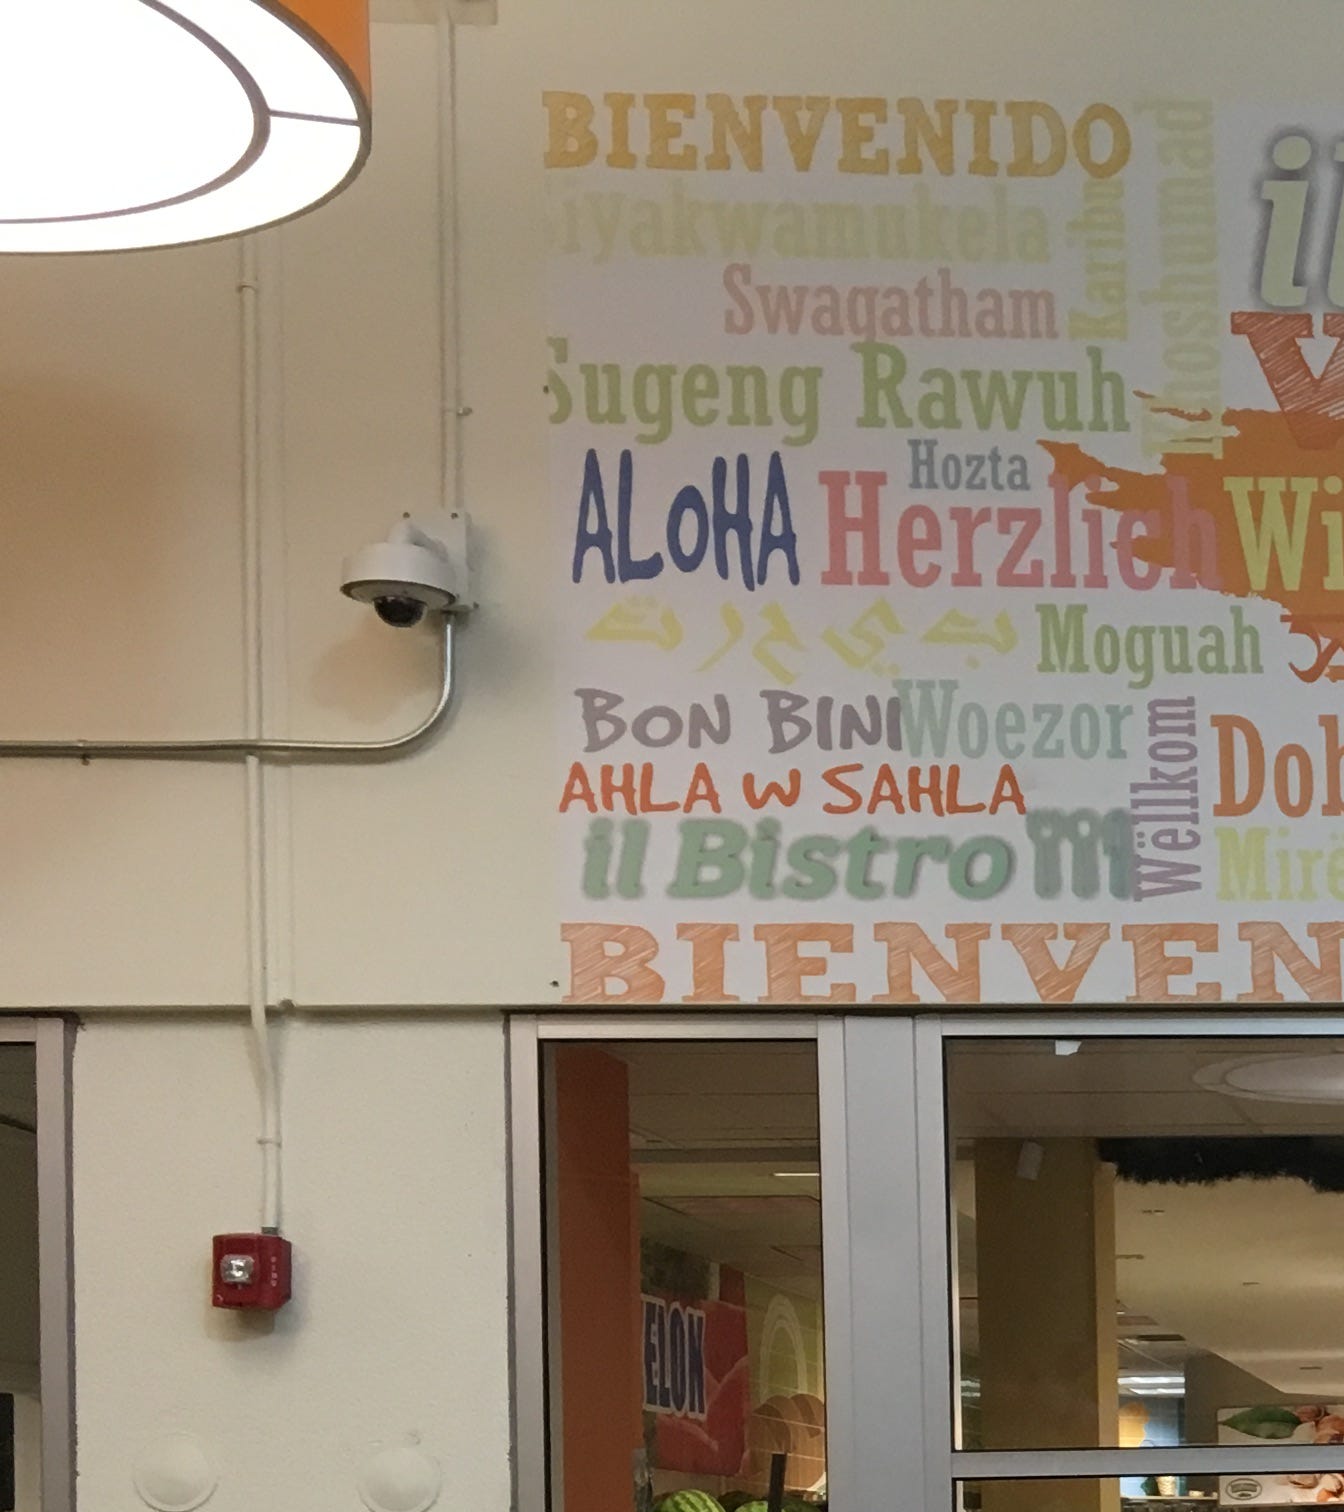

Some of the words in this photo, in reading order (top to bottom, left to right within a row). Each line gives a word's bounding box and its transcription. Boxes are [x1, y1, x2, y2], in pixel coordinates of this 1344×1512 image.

[541, 91, 1132, 178] BIENVENIDO
[851, 341, 1130, 432] Rawuh
[908, 439, 1030, 491] Hozta
[572, 448, 800, 592] ALOHA
[819, 469, 1224, 590] Herzlich
[1036, 603, 1264, 689] Moguah
[574, 687, 730, 753] BON
[759, 689, 900, 753] BINI
[894, 679, 1133, 760] Woezor
[558, 762, 722, 814] AHLA
[822, 762, 1027, 815] SAHLA
[582, 817, 650, 900] il
[667, 817, 1017, 900] Bistro
